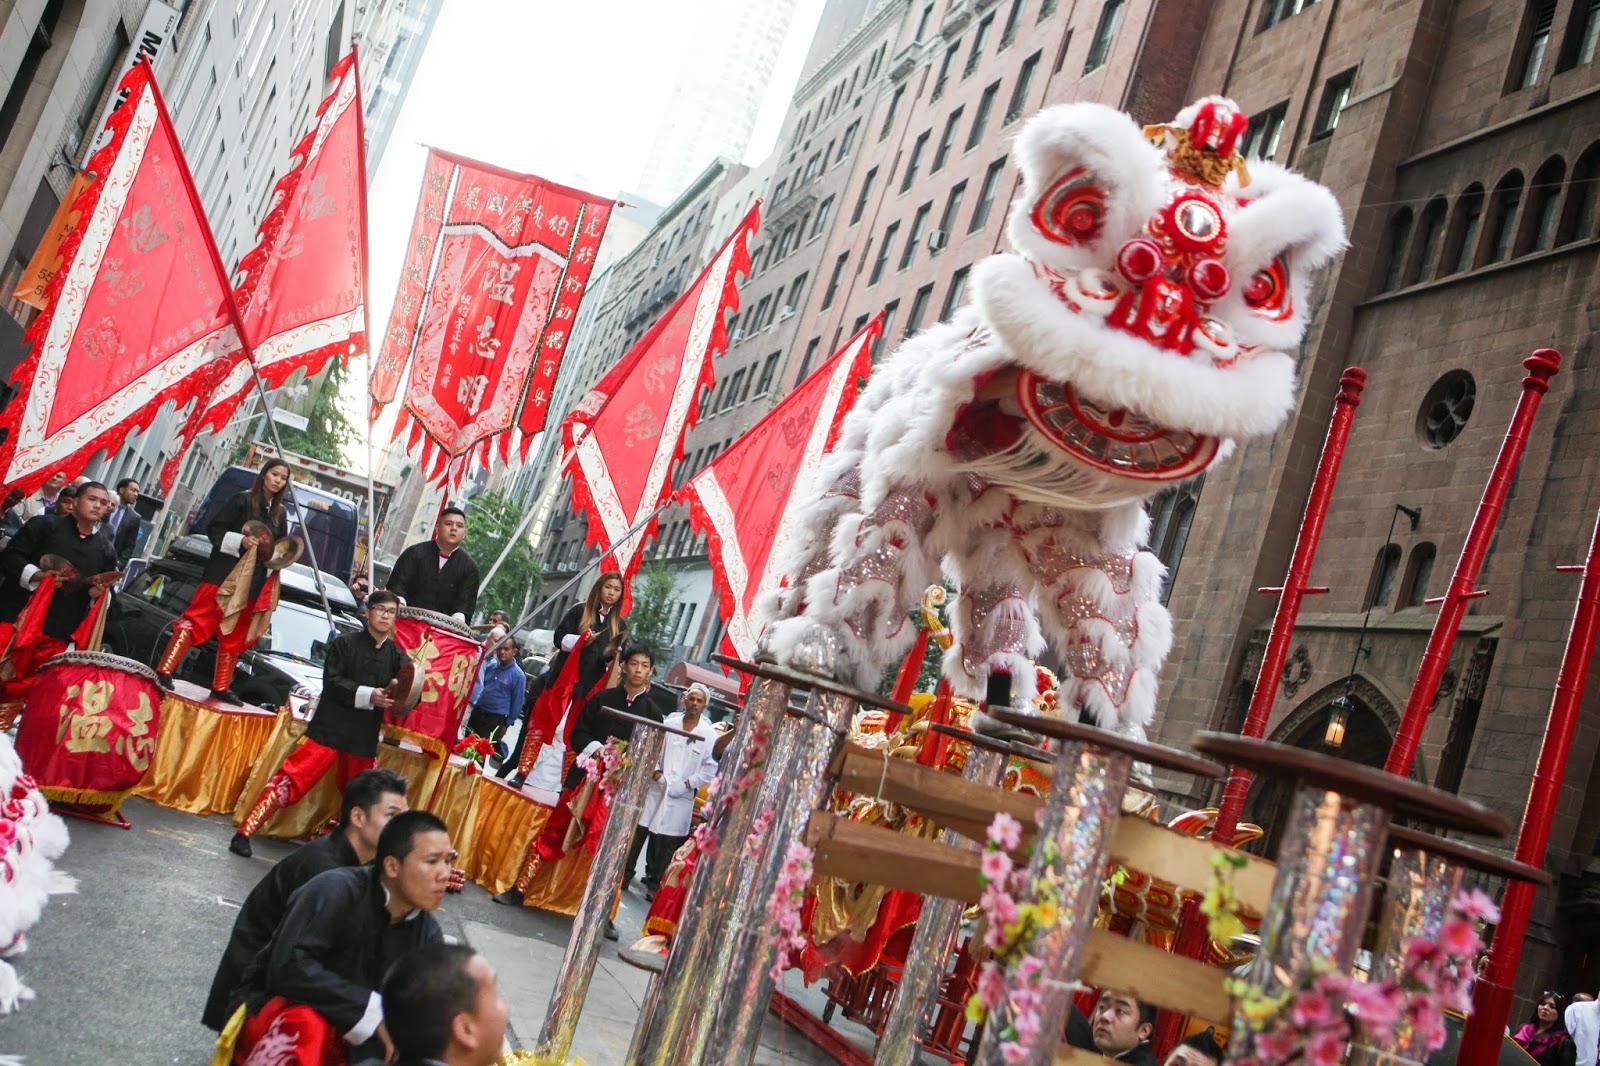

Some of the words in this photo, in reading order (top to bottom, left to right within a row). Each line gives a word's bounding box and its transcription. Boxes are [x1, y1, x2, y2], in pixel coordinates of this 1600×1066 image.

[164, 15, 174, 33] SALON
[96, 131, 104, 145] NEW
[456, 258, 521, 417] 溫志明
[55, 679, 156, 771] 溫志
